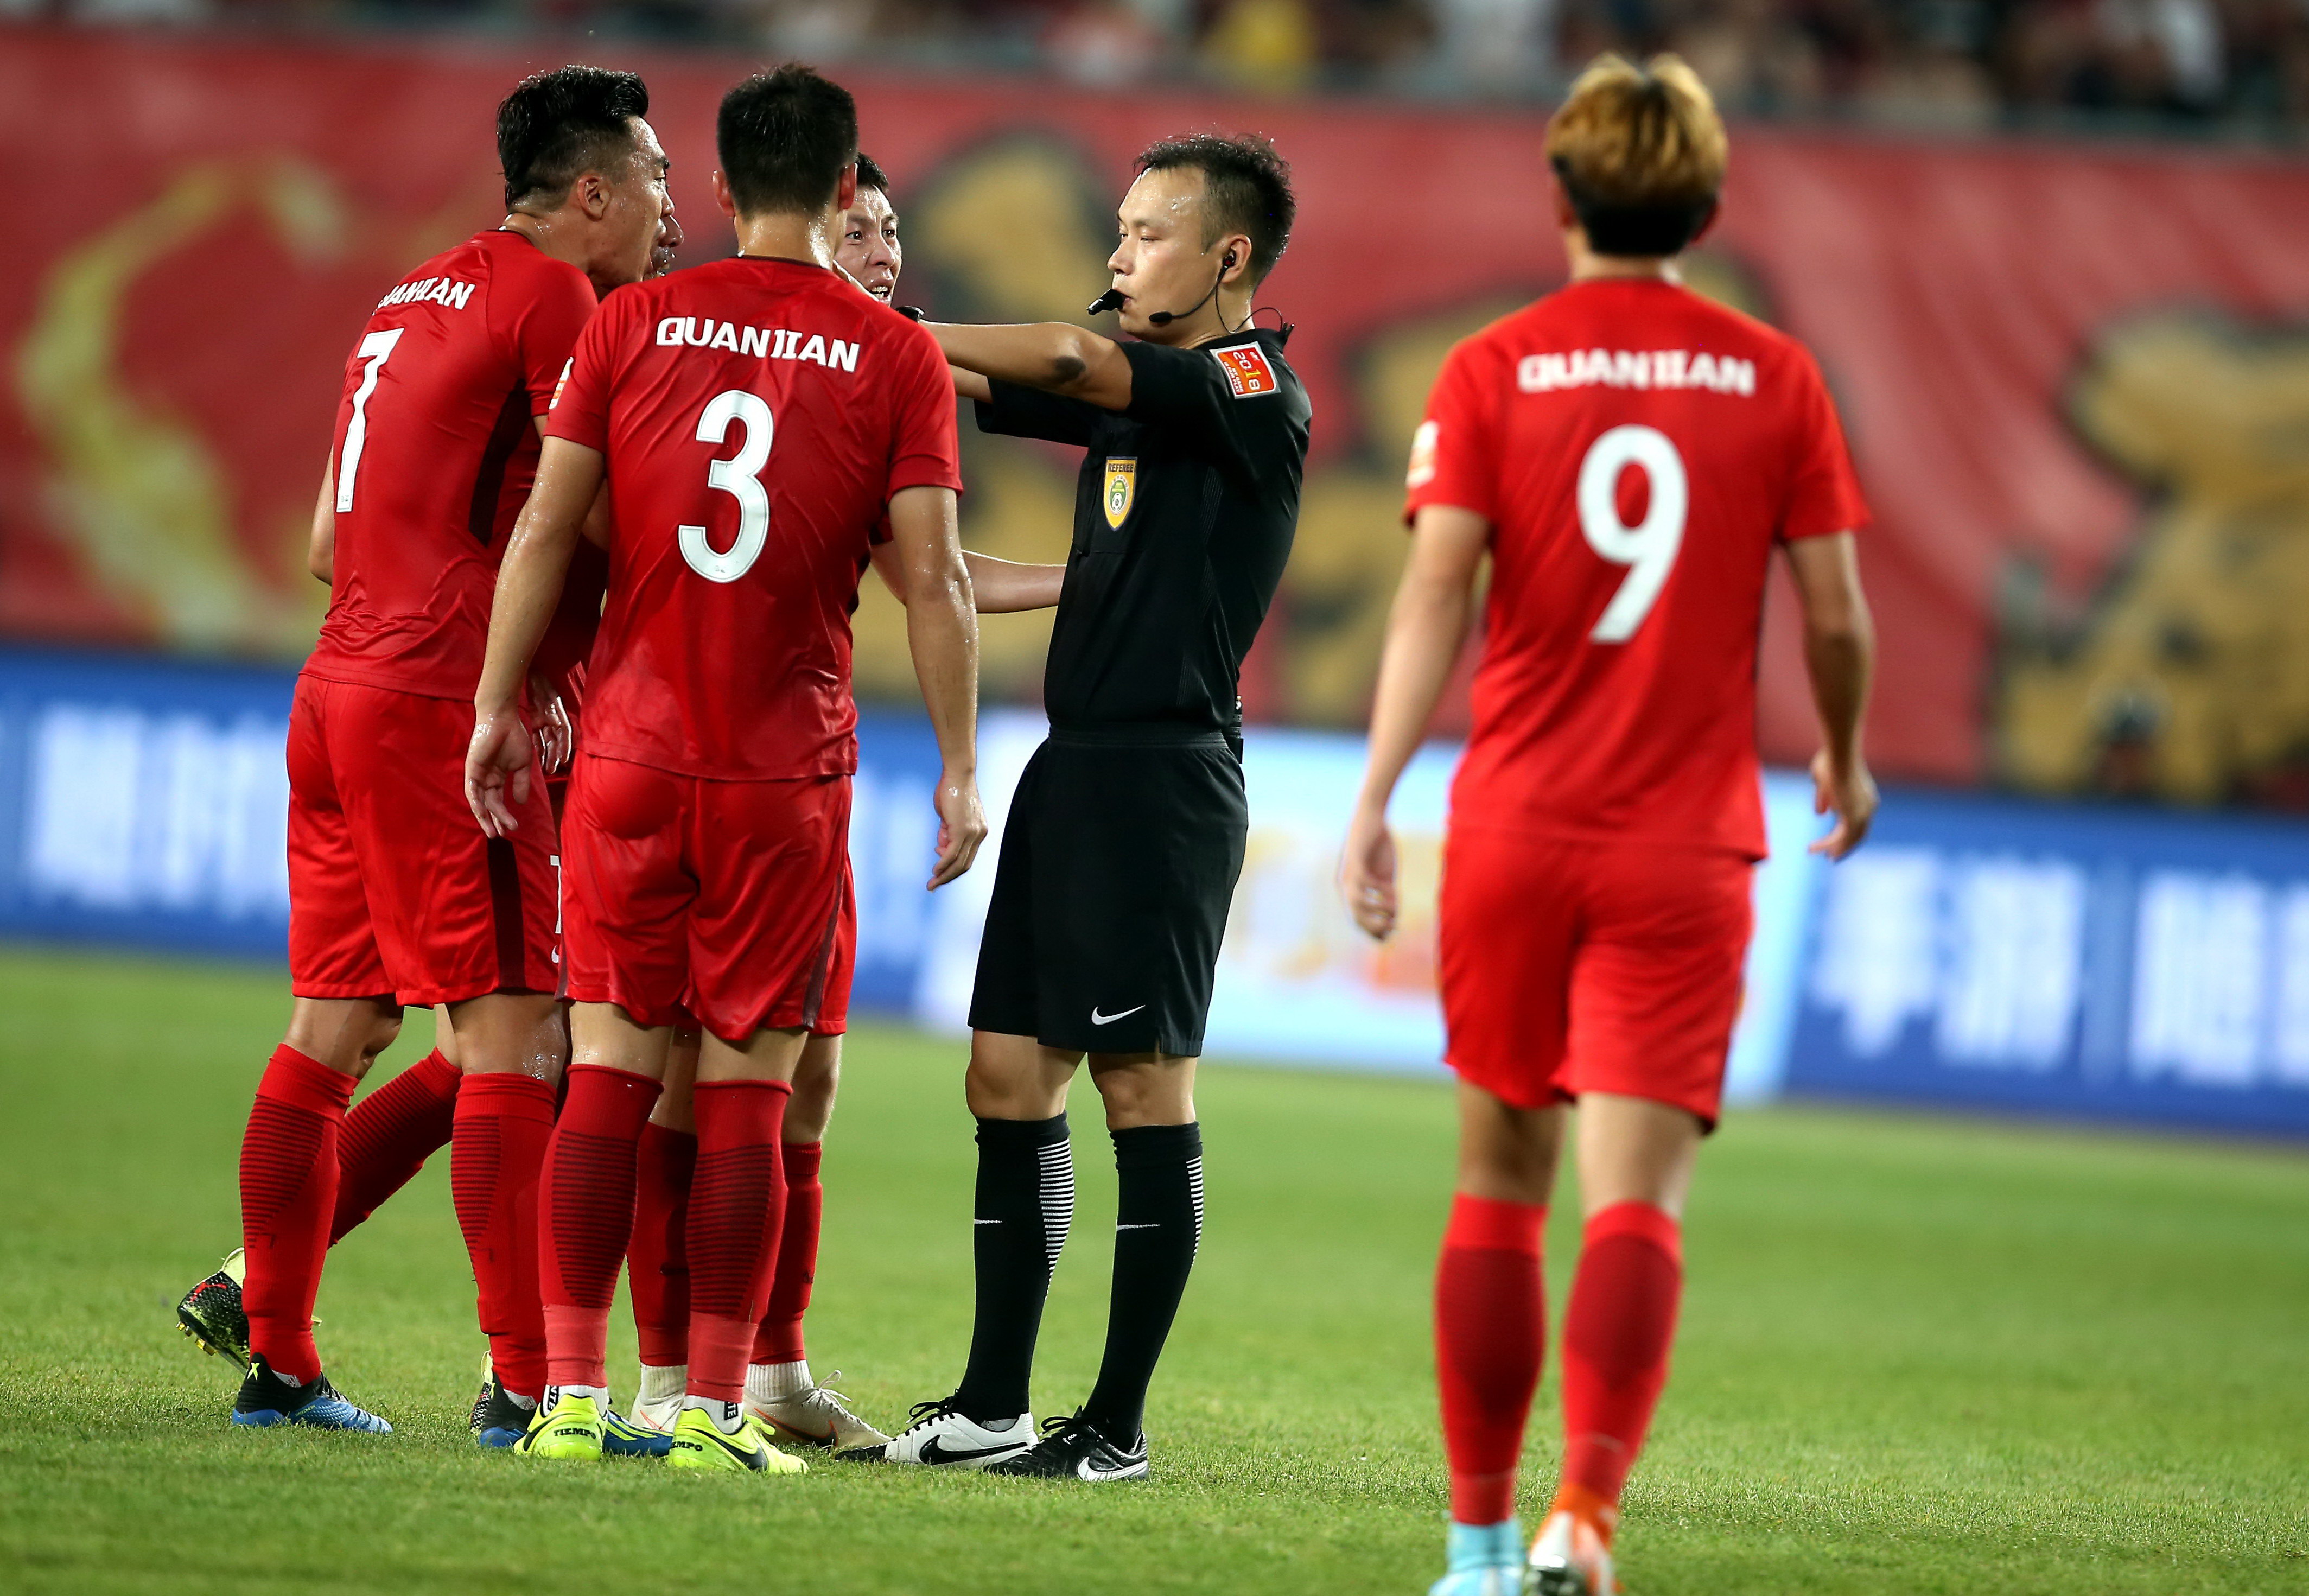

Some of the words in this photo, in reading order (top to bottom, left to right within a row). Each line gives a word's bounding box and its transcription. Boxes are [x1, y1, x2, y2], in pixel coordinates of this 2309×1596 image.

[372, 277, 475, 316] UANJIAN
[656, 316, 860, 373] QUANJIAN
[1233, 352, 1261, 390] 2018
[336, 327, 404, 513] 7
[678, 389, 774, 583] 3
[1108, 463, 1134, 473] REFEREE
[1576, 423, 1689, 644] 9
[553, 1428, 596, 1439] TIEMPO
